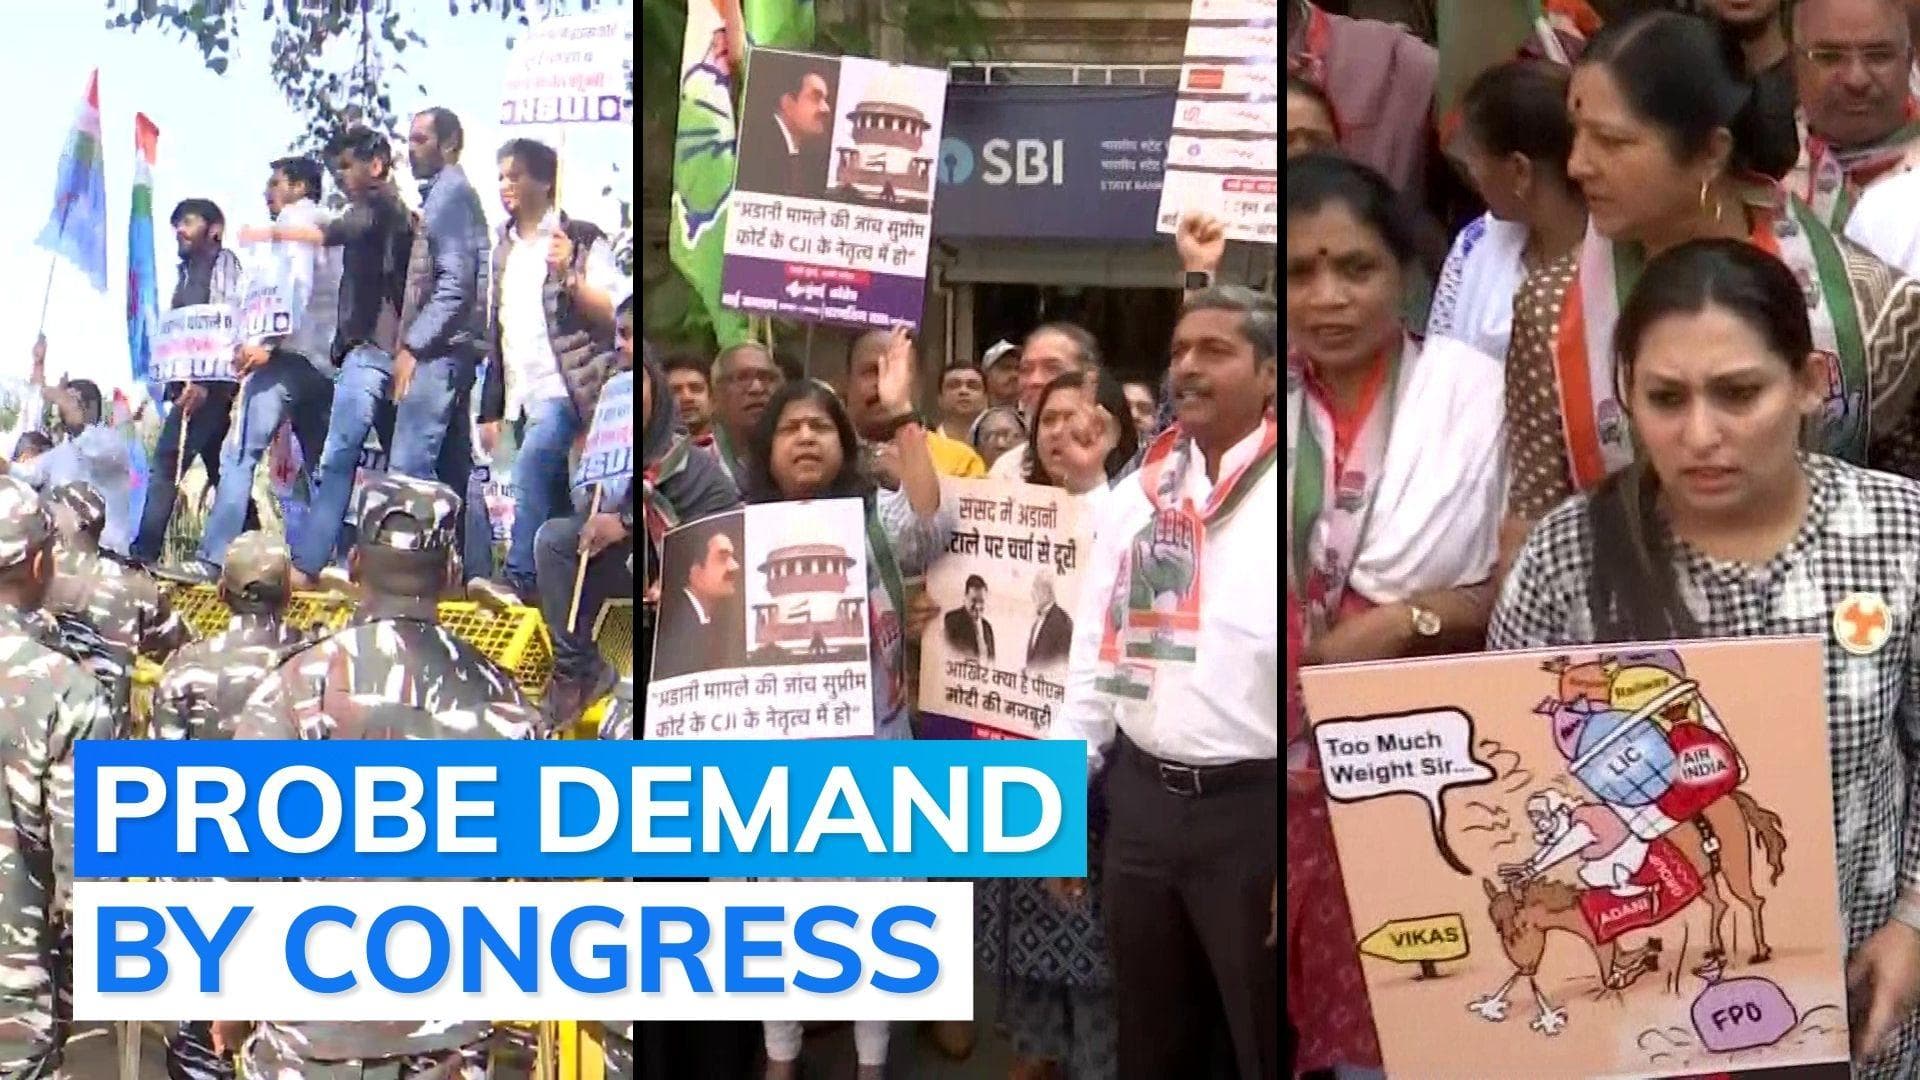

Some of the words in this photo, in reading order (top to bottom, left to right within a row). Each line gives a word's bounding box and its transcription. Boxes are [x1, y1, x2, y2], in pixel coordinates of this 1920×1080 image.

[982, 138, 1064, 185] SBI
[786, 206, 826, 228] मामले
[830, 208, 850, 230] की
[736, 225, 768, 248] कोर्ट
[769, 229, 785, 250] के
[789, 236, 812, 254] CJI
[816, 235, 832, 255] के
[877, 241, 889, 263] में
[959, 494, 997, 522] संसद
[1017, 500, 1057, 529] अडानी
[984, 533, 1004, 560] पर
[1007, 532, 1034, 563] चर्चा
[1036, 535, 1051, 565] से
[1054, 537, 1077, 576] दूरी
[704, 674, 749, 700] मामले
[755, 672, 777, 697] की
[784, 674, 818, 695] जांच
[822, 669, 867, 700] सुप्रीम
[945, 657, 990, 684] आखिर
[992, 666, 1017, 690] क्या
[1019, 667, 1029, 694] है
[1031, 673, 1066, 704] पीएम
[655, 711, 685, 738] कोर्ट
[689, 711, 705, 733] के
[710, 713, 737, 732] CJI
[743, 707, 760, 729] के
[765, 705, 810, 735] नेतृत्व
[816, 701, 829, 726] में
[944, 683, 979, 708] मोदी
[982, 690, 1001, 713] की
[1003, 697, 1053, 730] मजबूरी
[1325, 738, 1370, 756] Too
[1377, 729, 1442, 752] Much
[1683, 748, 1711, 763] AIR
[1331, 760, 1415, 784] Weight
[1607, 746, 1642, 776] LIC
[1683, 759, 1728, 779] INDIA
[1389, 927, 1460, 947] VIKAS
